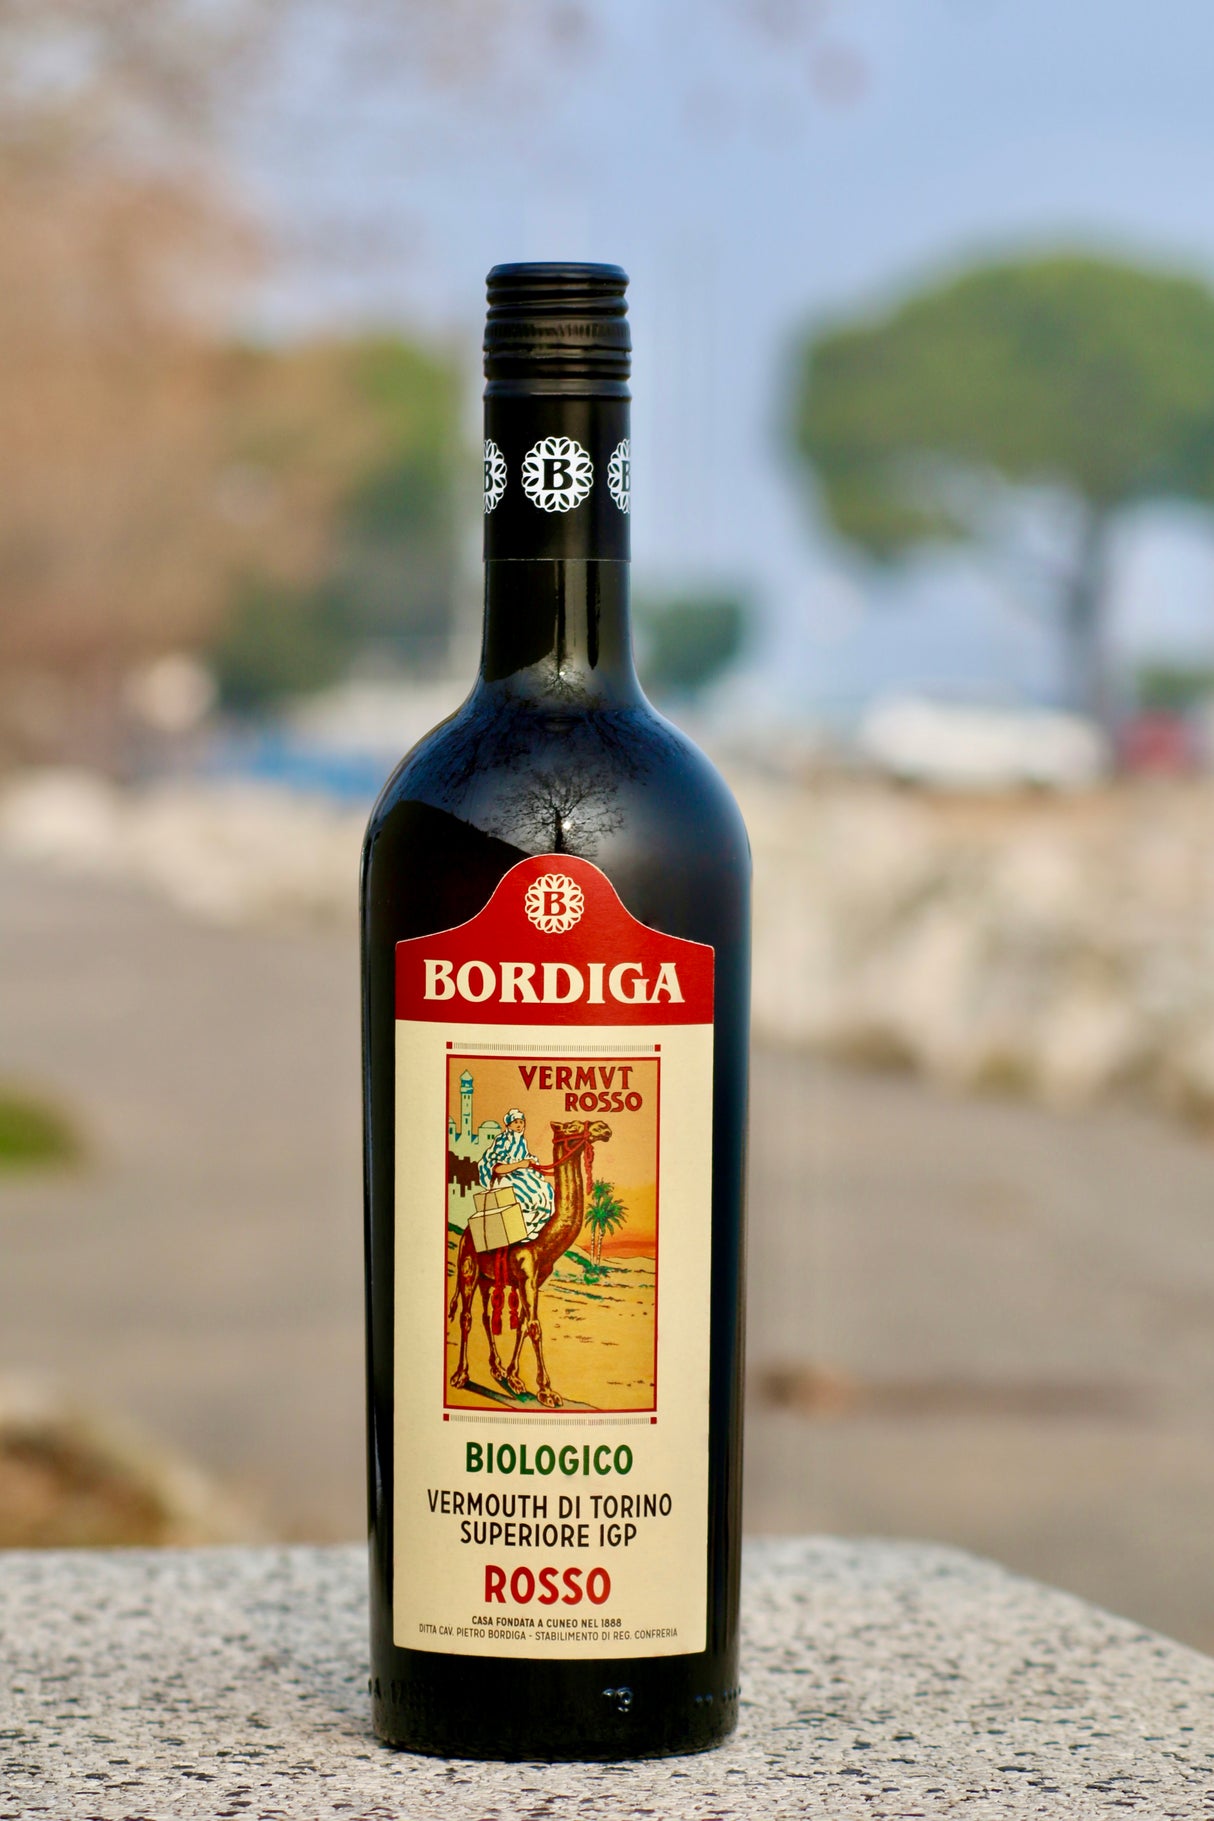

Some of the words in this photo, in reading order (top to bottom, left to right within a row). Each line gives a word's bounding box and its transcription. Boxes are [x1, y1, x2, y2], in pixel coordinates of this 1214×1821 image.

[542, 458, 574, 491] B
[542, 891, 567, 917] B
[423, 959, 686, 1004] BORDIGA
[564, 1091, 643, 1113] ROSSO
[465, 1441, 634, 1476] BIOLOGICO
[427, 1489, 548, 1519] VERMOUTH
[558, 1495, 581, 1519] DI
[590, 1492, 673, 1519] TORINO
[460, 1520, 590, 1548] SUPERIORE
[599, 1523, 638, 1547] IGP
[484, 1564, 612, 1606] ROSSO
[419, 1623, 437, 1634] DITTA
[456, 1628, 486, 1639] PIETRO
[488, 1629, 527, 1641] BORDIGA
[535, 1631, 599, 1641] STABILIMENTO
[601, 1631, 611, 1640] DI
[613, 1630, 632, 1640] REG.
[634, 1628, 678, 1639] CONFRERIA
[471, 1615, 494, 1626] CASA
[496, 1617, 535, 1628] FONDATA
[537, 1618, 544, 1628] A
[546, 1619, 578, 1628] CUNEO
[581, 1619, 599, 1628] NEL
[601, 1618, 622, 1628] 1888
